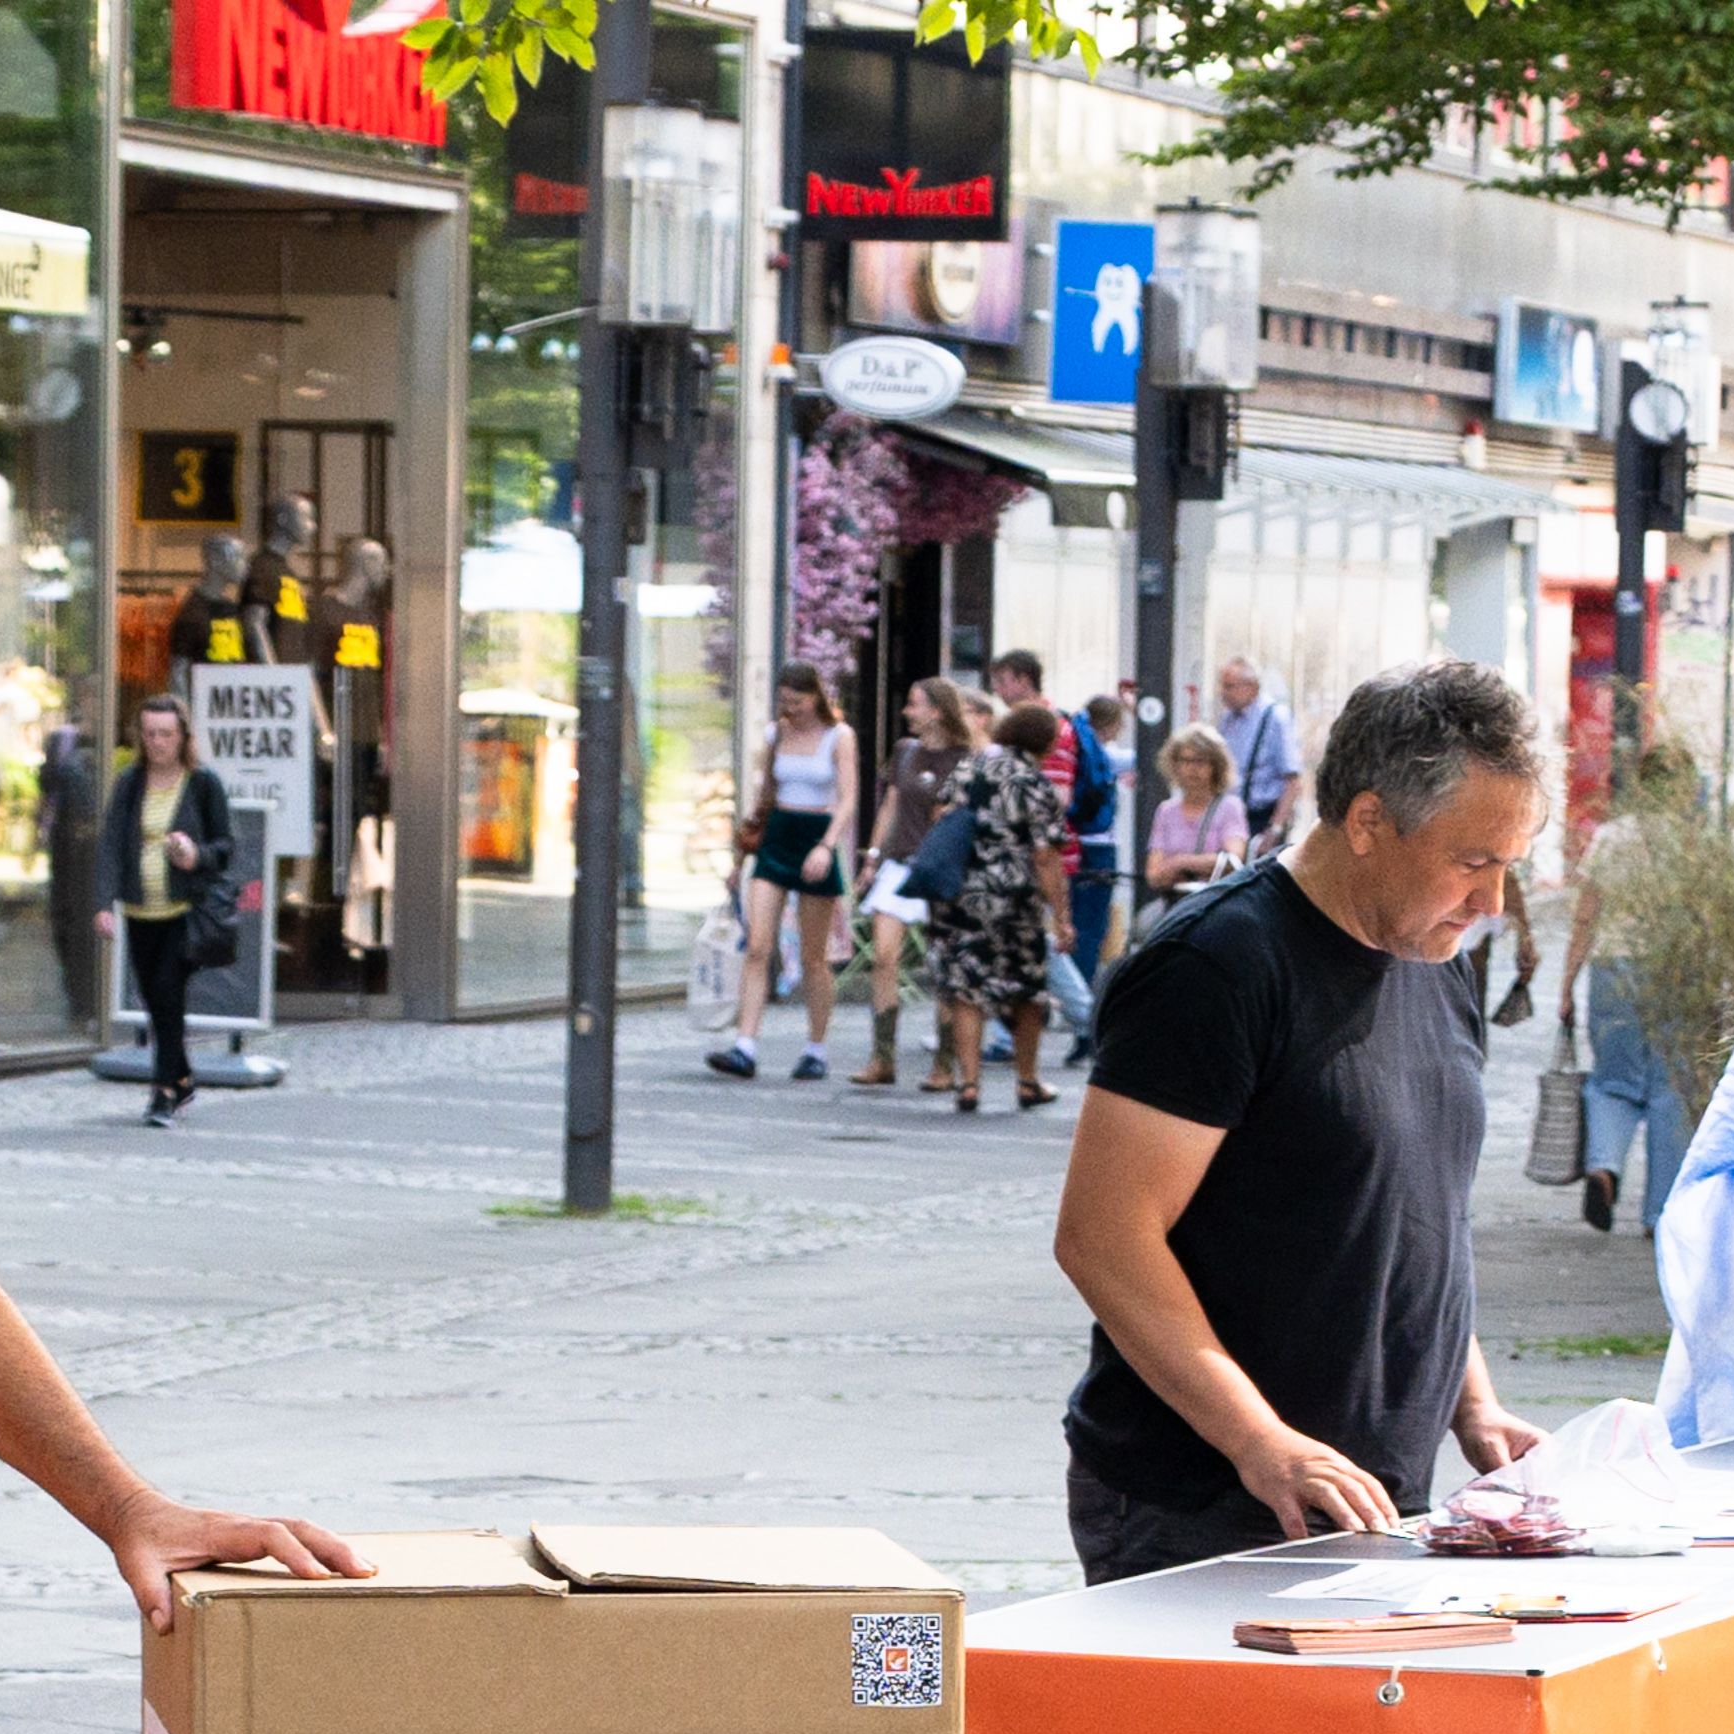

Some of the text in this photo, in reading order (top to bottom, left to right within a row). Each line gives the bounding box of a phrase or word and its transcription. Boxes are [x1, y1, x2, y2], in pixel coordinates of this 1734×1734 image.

[172, 446, 204, 508] 3
[207, 685, 296, 719] MENS
[207, 726, 295, 759] WEAR
